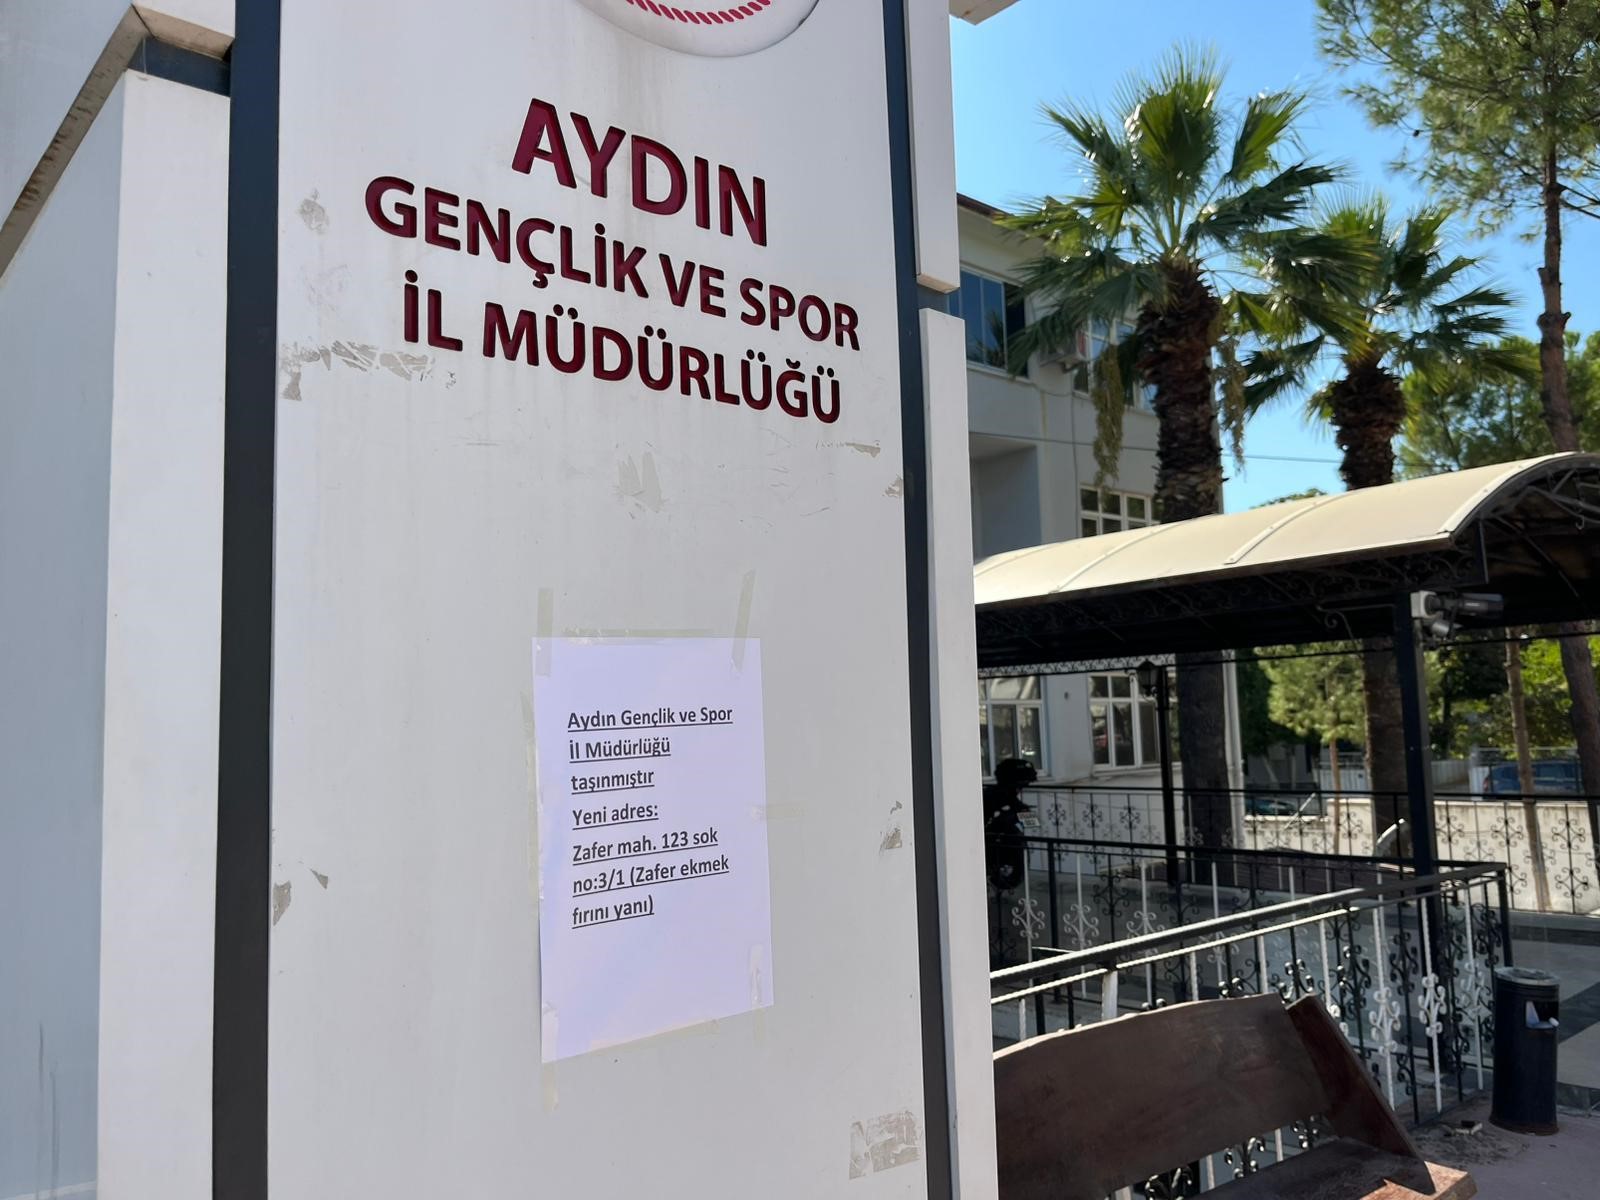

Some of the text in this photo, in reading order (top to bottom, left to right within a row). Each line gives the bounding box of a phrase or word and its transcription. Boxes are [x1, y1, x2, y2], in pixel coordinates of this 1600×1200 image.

[511, 97, 767, 247] AYDIN
[364, 175, 861, 351] GENÇLİK VE SPOR
[403, 269, 841, 424] İL MÜDÜRLÜĞÜ
[567, 706, 733, 731] Aydın Gençlik ve Spor
[569, 737, 671, 760] İl Müdürlüğü
[570, 769, 655, 792] taşınmıştır
[572, 802, 659, 826] Yeni adres:
[572, 827, 719, 862] Zafer mah. 123 sok
[572, 854, 730, 893] no:3/1 (Zafer ekmek
[572, 894, 655, 926] fırını yanı)
